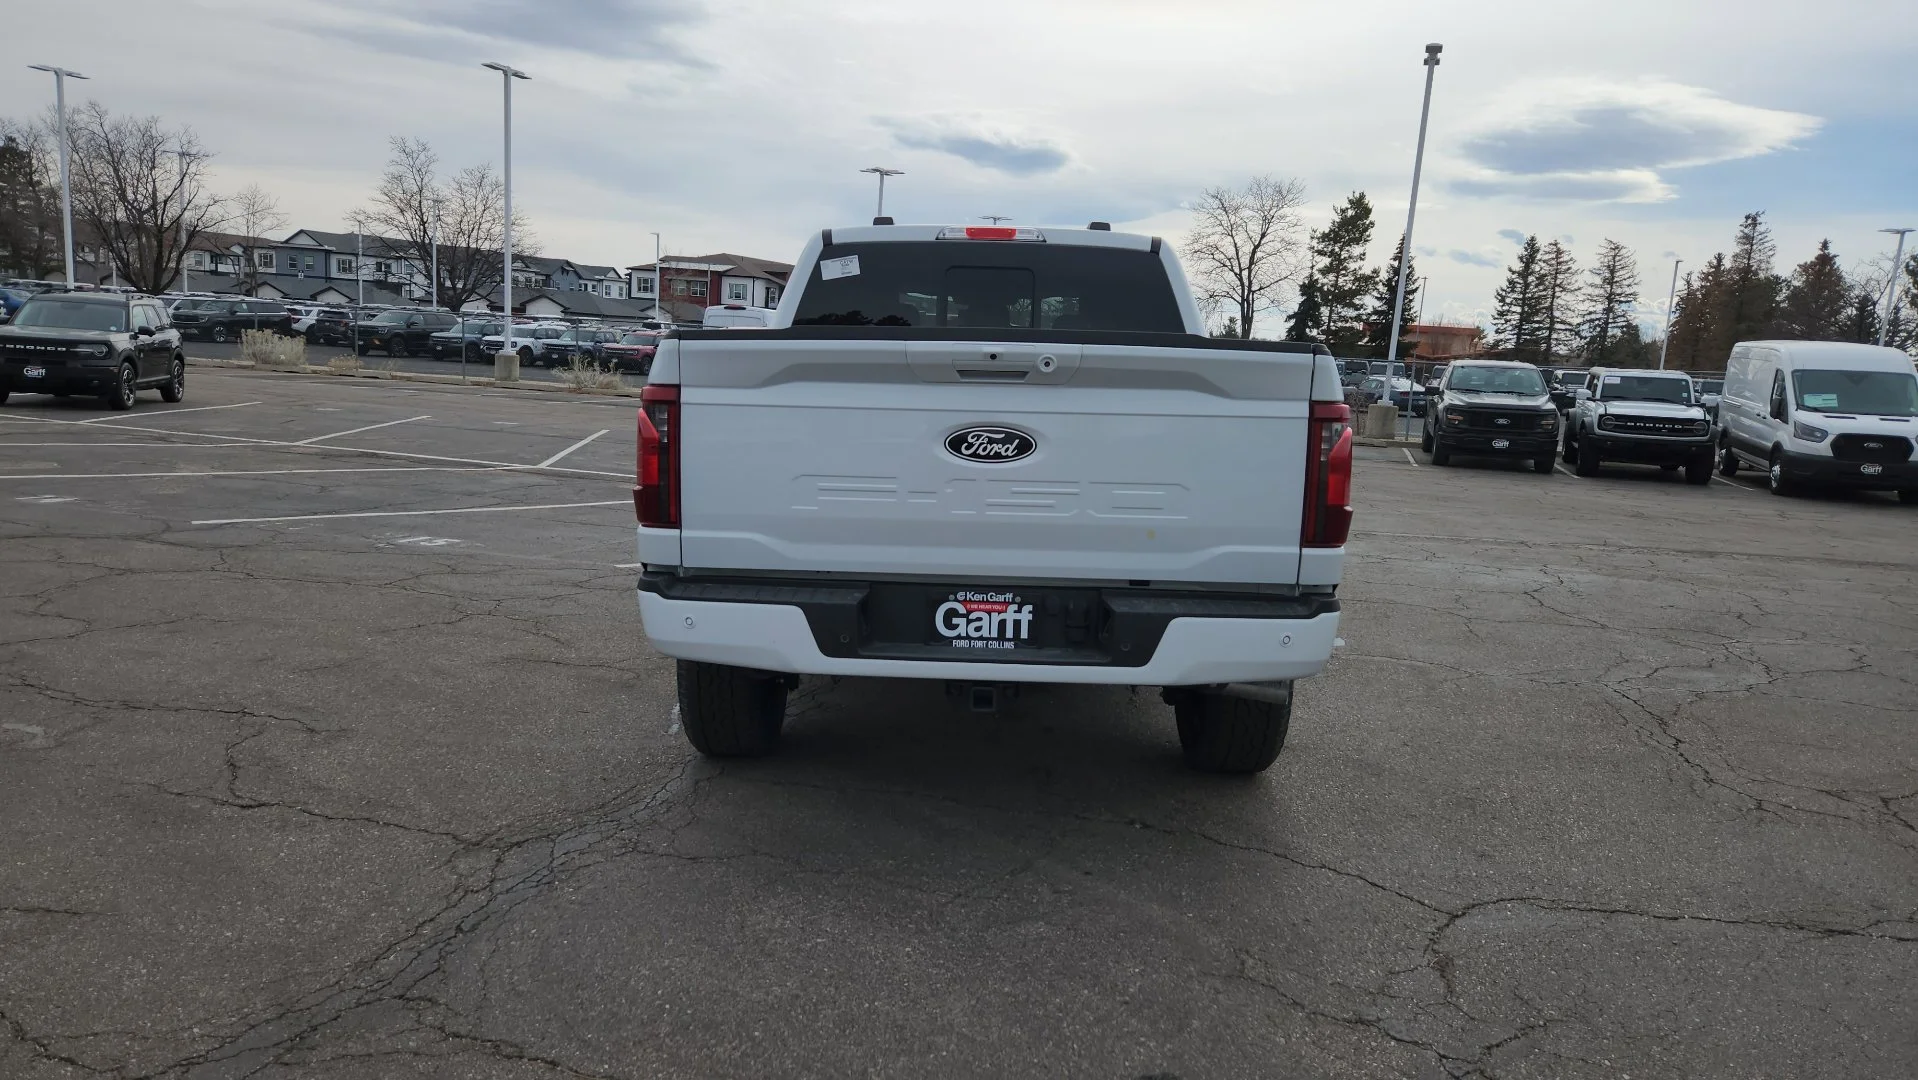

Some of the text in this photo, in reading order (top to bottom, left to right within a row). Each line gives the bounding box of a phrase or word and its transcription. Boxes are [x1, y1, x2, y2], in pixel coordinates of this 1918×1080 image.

[23, 367, 46, 376] Garff
[961, 431, 1020, 456] Ford
[1492, 439, 1510, 448] Garff
[1860, 464, 1883, 473] Garff
[966, 592, 1014, 602] Ken Garff
[935, 601, 1033, 639] Garff
[952, 639, 1015, 650] FORD FORT COLLINS
